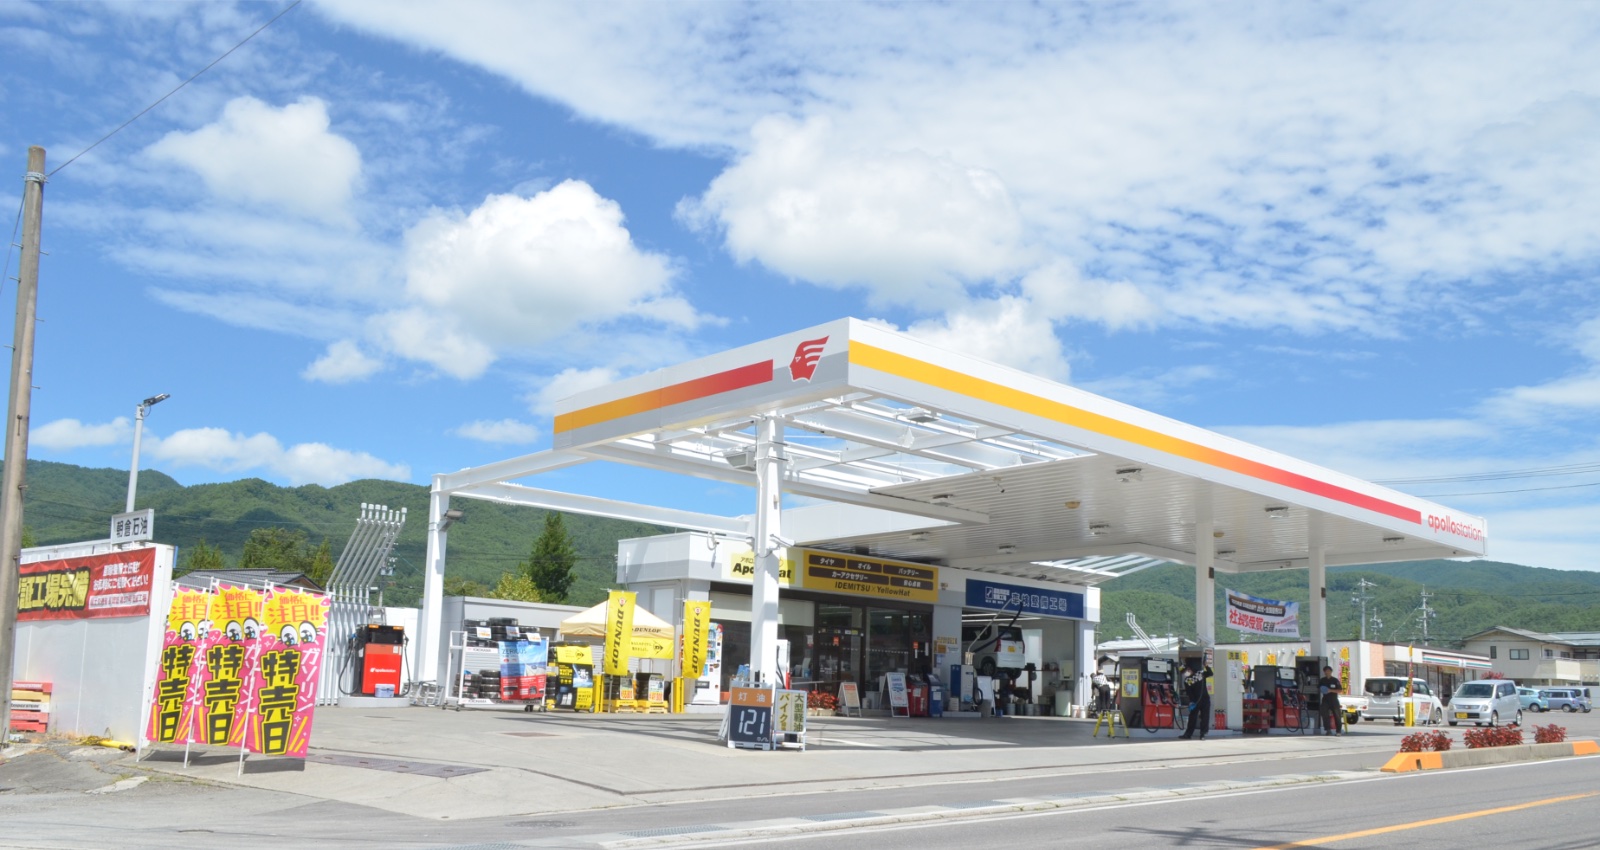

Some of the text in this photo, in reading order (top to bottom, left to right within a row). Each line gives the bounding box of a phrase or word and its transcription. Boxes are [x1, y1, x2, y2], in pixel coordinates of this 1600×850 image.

[116, 516, 148, 538] 朝倉石油
[1428, 514, 1483, 541] apollostation
[819, 558, 835, 566] タイヤ
[857, 563, 872, 571] オイル
[898, 568, 920, 576] バッテリー
[831, 571, 868, 581] カーアクセサリー
[834, 581, 870, 592] IDEMITSU
[224, 593, 253, 602] 価格に
[279, 595, 306, 605] 価格に
[268, 604, 319, 625] 注目!!
[612, 609, 624, 669] DUNLOP
[692, 617, 700, 674] DUNLOP
[297, 648, 320, 712] ガソリン
[159, 645, 196, 743] 特売日
[204, 645, 245, 746] 特売日
[259, 649, 301, 755] 特売日
[738, 692, 766, 703] 灯油
[738, 709, 766, 735] 121
[794, 693, 804, 732] 大型軽油
